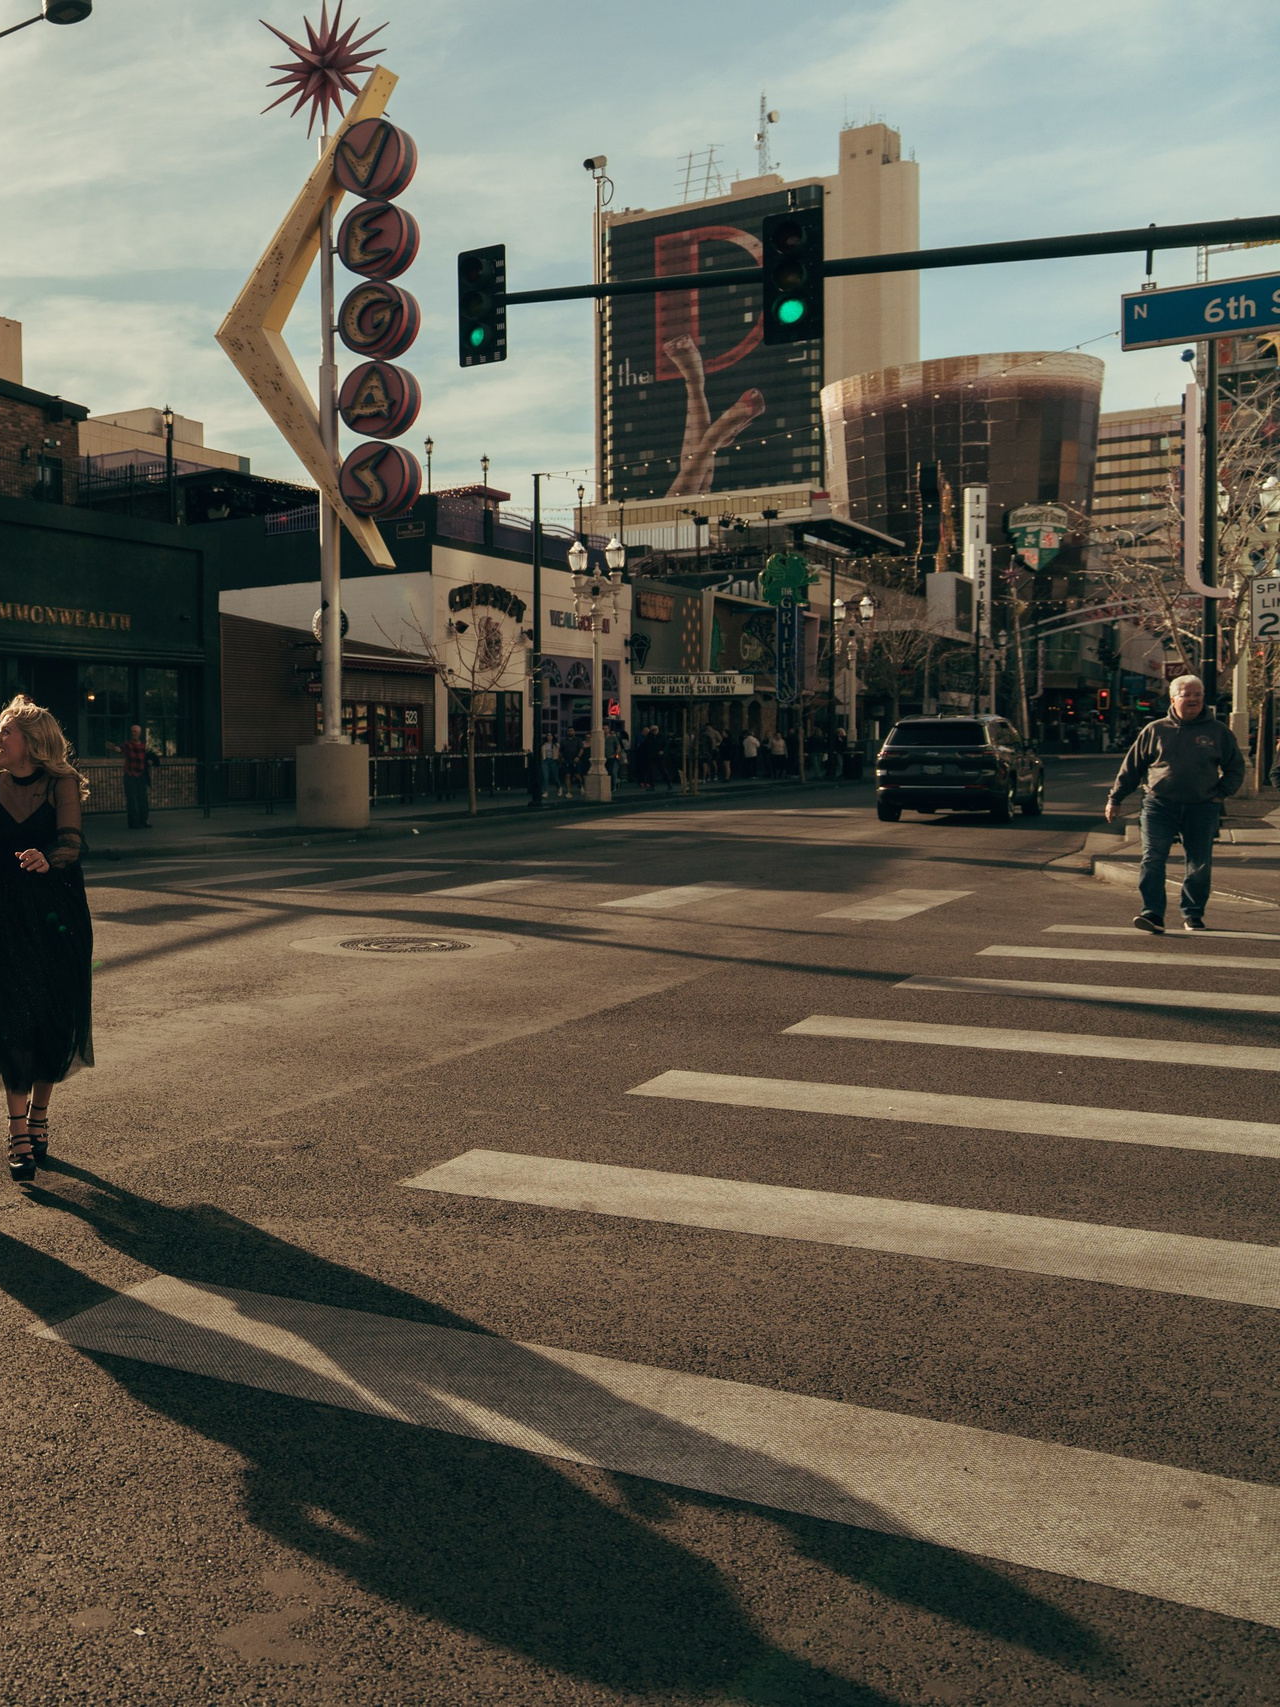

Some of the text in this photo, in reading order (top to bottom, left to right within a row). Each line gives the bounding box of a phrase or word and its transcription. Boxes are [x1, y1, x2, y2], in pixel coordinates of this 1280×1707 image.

[339, 122, 404, 508] VEGAS
[1133, 303, 1148, 320] N
[1204, 294, 1256, 323] 6th
[617, 357, 650, 387] the
[1256, 582, 1280, 595] SP
[1262, 596, 1280, 608] LI
[780, 596, 793, 699] GRIFFIN
[634, 675, 643, 685] EL
[646, 675, 690, 685] BOOGIEMAN
[715, 675, 736, 685] VINYL
[741, 675, 753, 685] FRI
[650, 685, 736, 694] MEZ MATOS SATURDAY
[404, 710, 418, 725] 523
